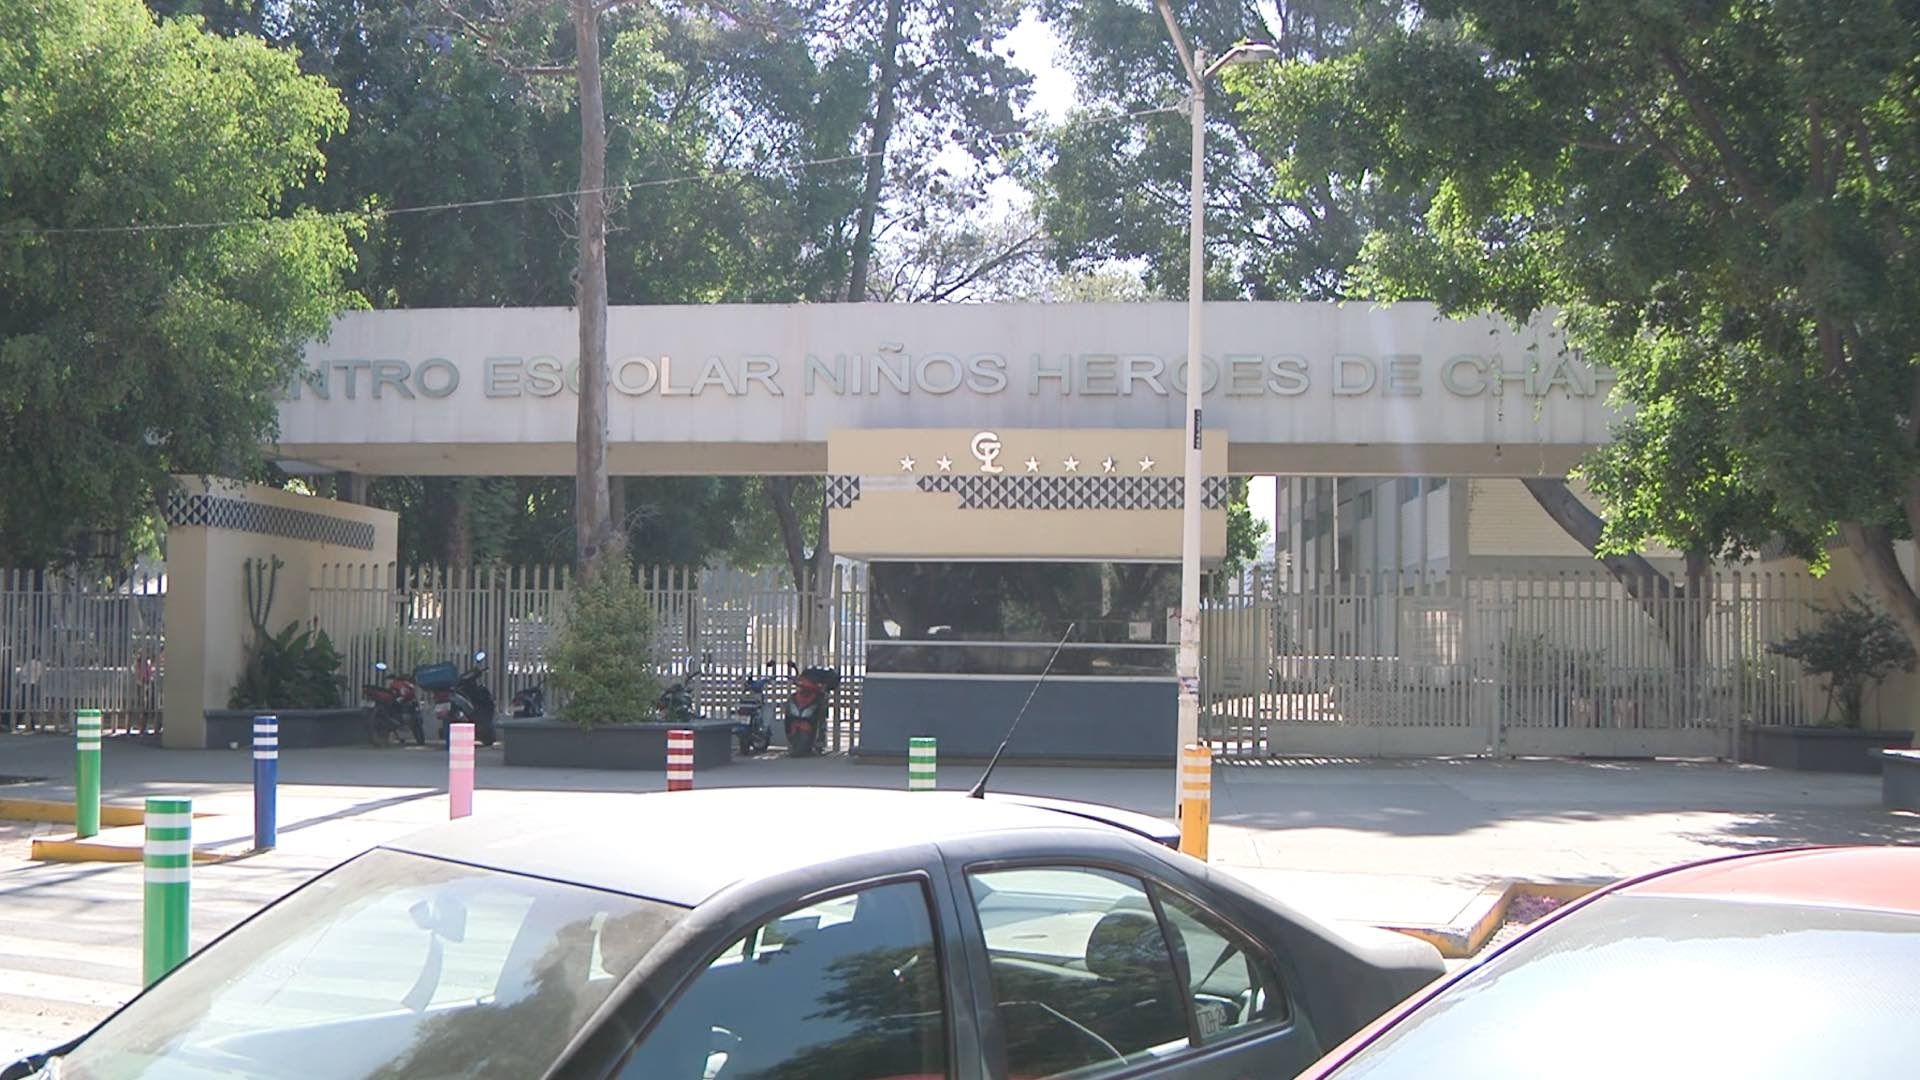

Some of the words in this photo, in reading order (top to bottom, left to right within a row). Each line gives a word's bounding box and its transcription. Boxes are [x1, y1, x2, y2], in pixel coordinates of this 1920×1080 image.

[804, 341, 1008, 396] NIÑOS
[1029, 353, 1311, 397] HEROES
[1332, 353, 1423, 397] DE
